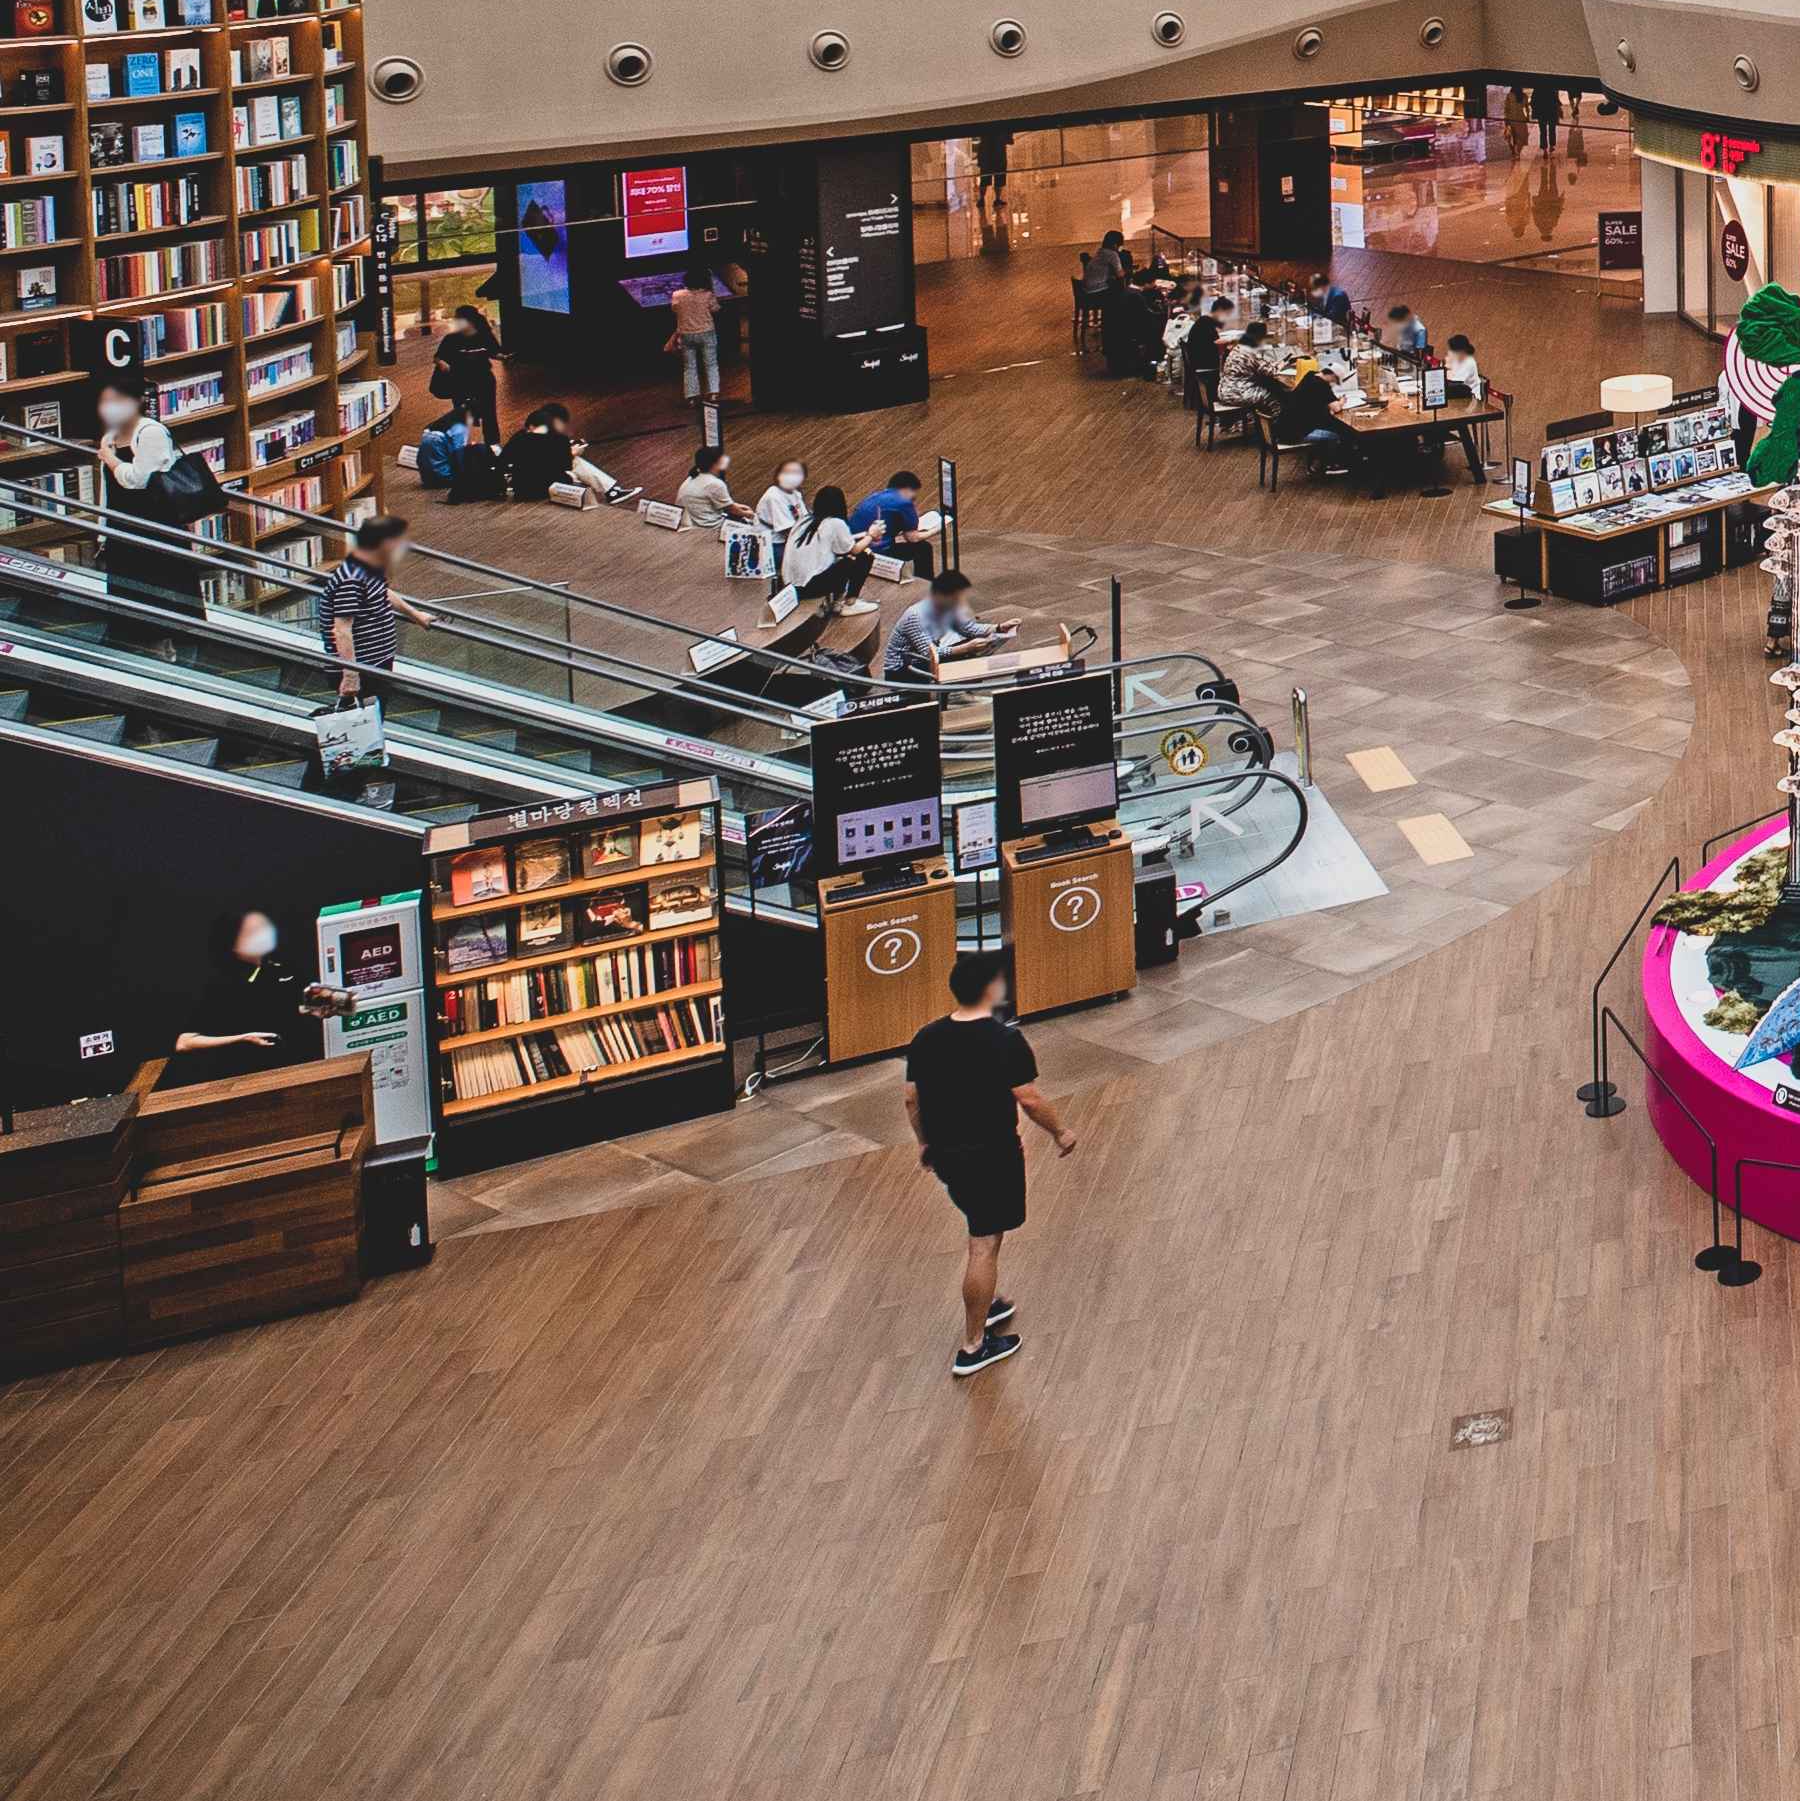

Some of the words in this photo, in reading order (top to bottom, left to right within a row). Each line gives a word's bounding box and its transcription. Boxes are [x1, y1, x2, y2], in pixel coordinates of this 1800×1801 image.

[1605, 225, 1637, 235] SALE
[1726, 242, 1746, 260] SALE
[105, 328, 131, 368] C
[508, 804, 572, 829] 별마당
[578, 789, 644, 818] 컬렉션
[1050, 879, 1072, 889] Book
[360, 945, 394, 961] AED
[366, 1008, 401, 1025] AED
